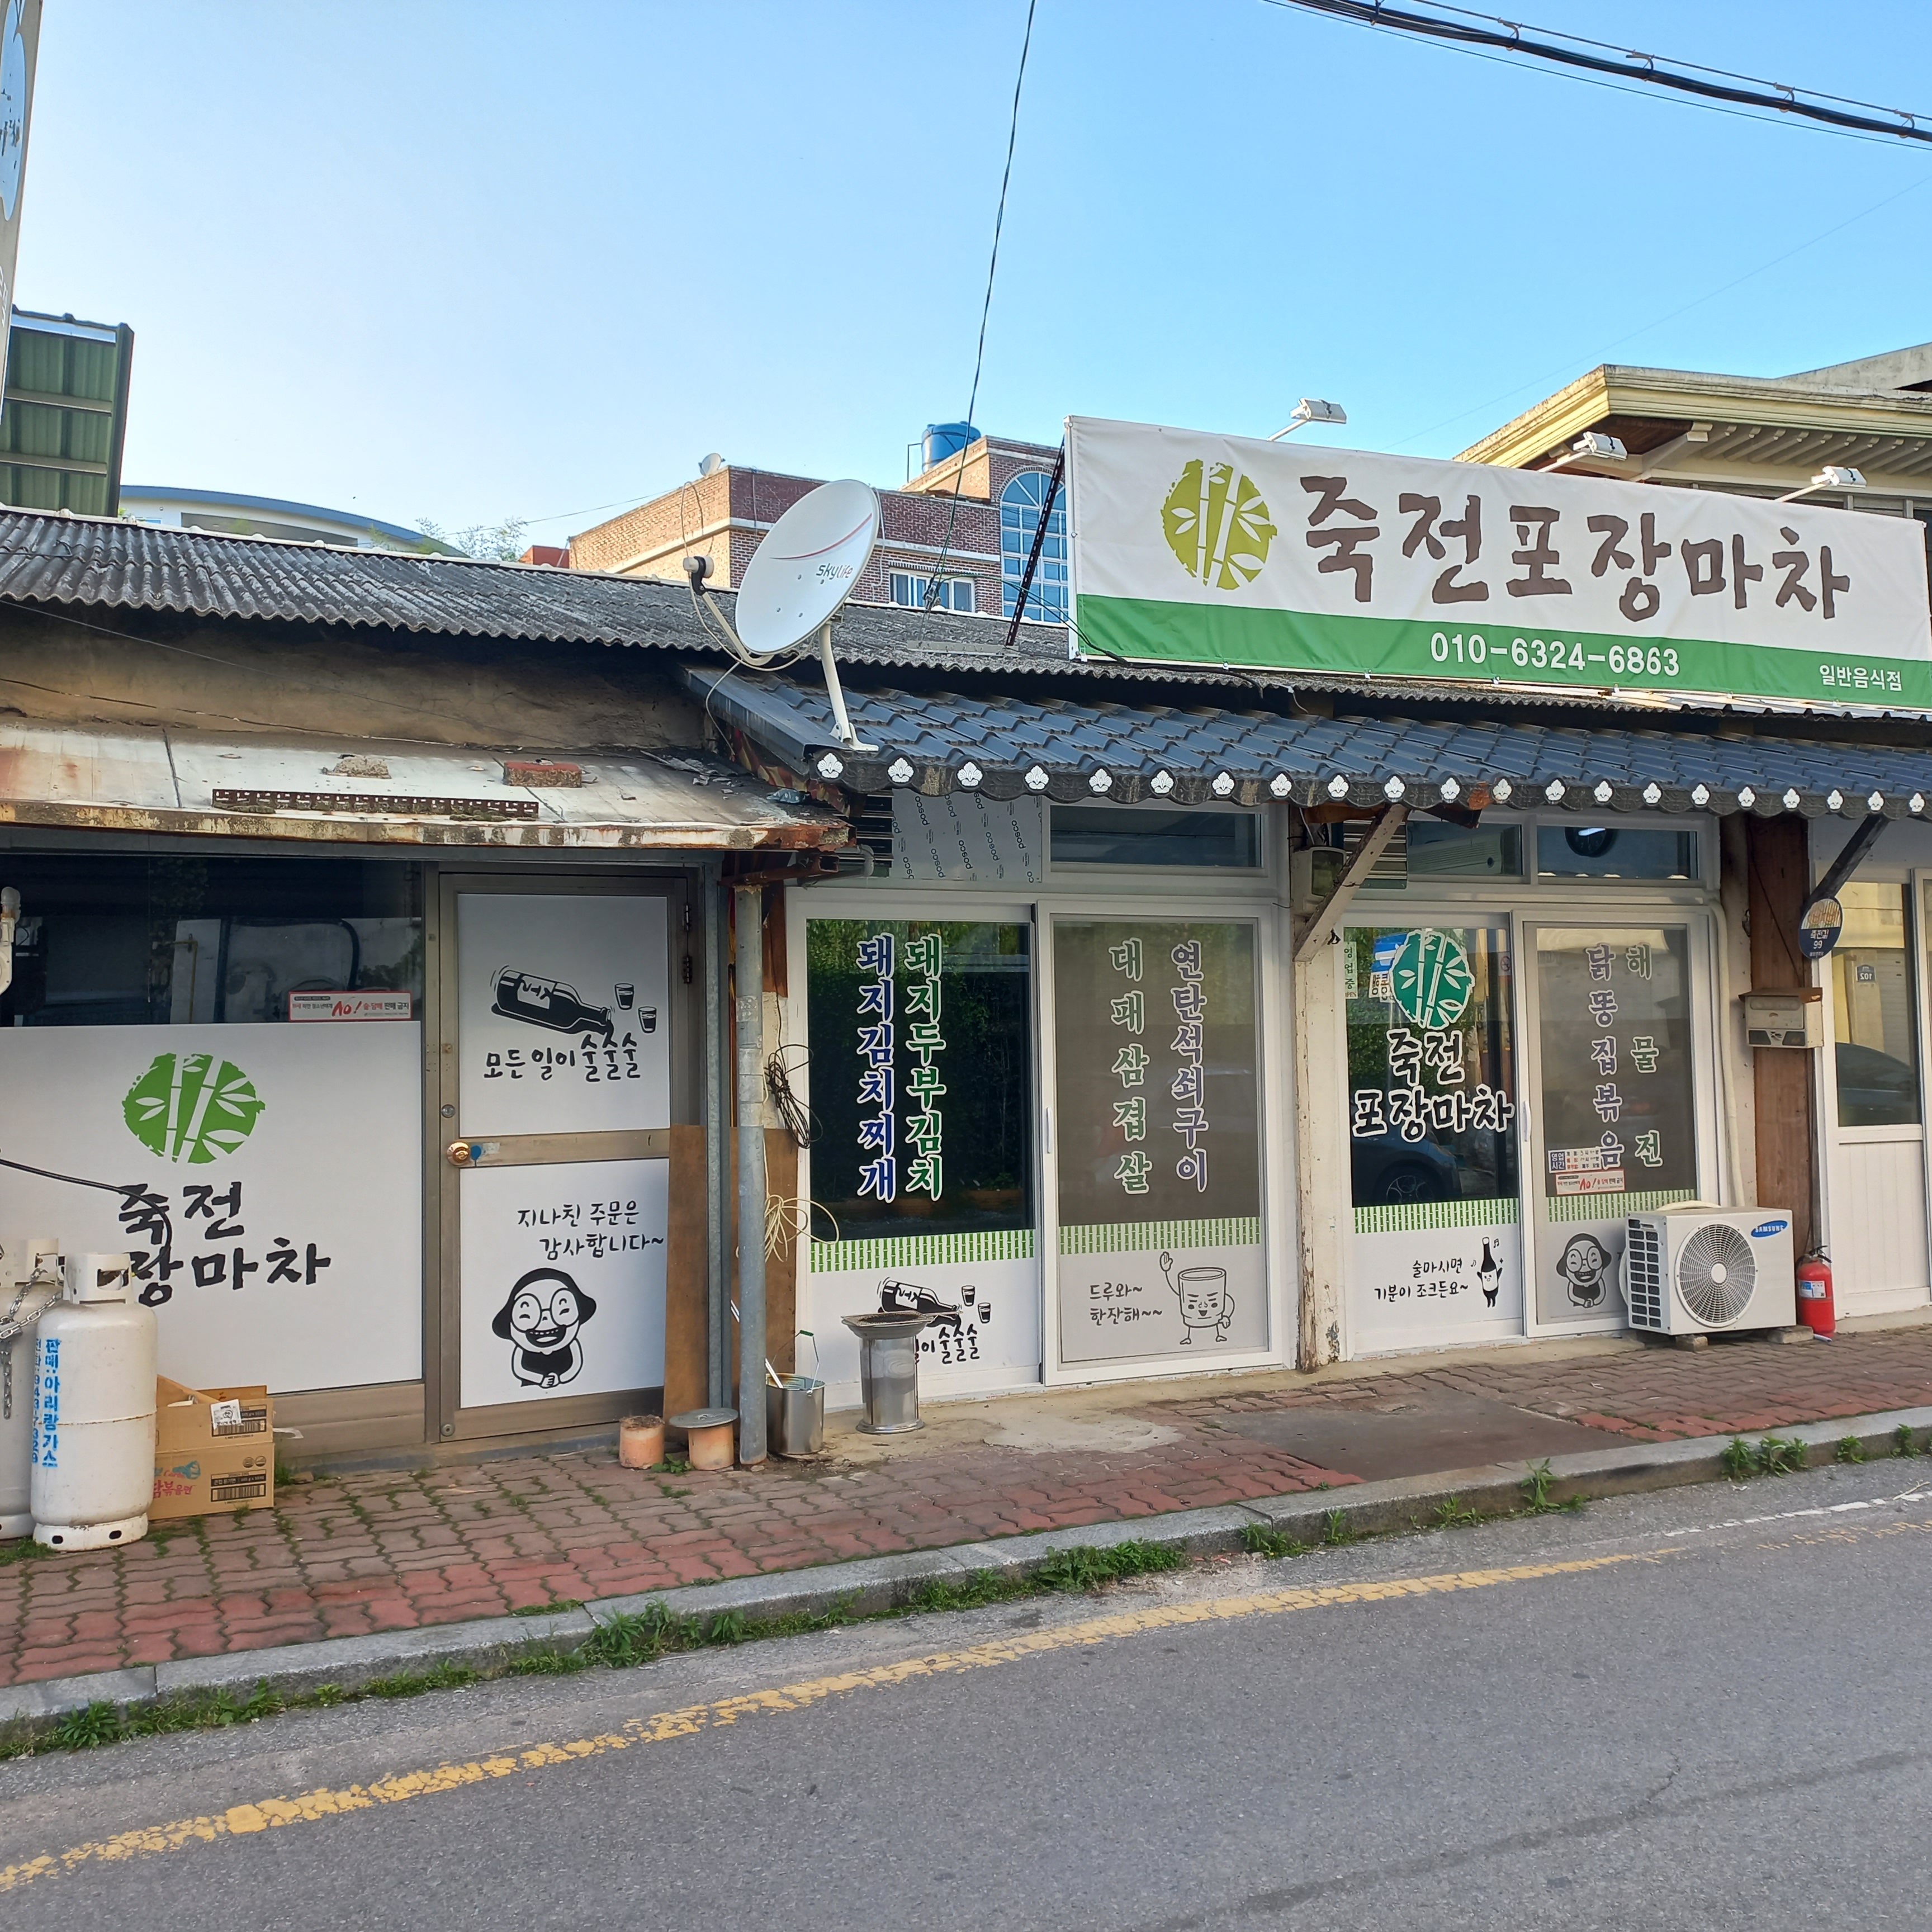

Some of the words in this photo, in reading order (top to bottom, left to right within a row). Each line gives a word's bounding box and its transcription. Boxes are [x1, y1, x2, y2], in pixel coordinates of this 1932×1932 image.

[1300, 475, 1850, 622] 죽전포장마차
[1430, 632, 1680, 676] 010-6324-6863
[1819, 664, 1902, 692] 일반음식점
[915, 795, 930, 826] posco
[986, 831, 1000, 861] posco
[1011, 820, 1026, 849] posco
[930, 848, 946, 878] posco
[958, 840, 973, 869] posco
[1813, 940, 1822, 949] 99
[484, 1048, 525, 1079] 모든
[531, 1046, 576, 1081] 일이
[580, 1031, 641, 1083] 술술술
[1386, 1027, 1465, 1086] 죽전
[1352, 1083, 1515, 1143] 포장마차
[1551, 1153, 1564, 1162] 영업
[1552, 1161, 1565, 1169] 시간
[119, 1181, 245, 1245] 죽전
[517, 1204, 581, 1228] 지나친
[589, 1200, 640, 1226] 주문은
[1755, 1224, 1785, 1233] SAMSUNG
[539, 1233, 664, 1261] 감사합니다~
[122, 1237, 331, 1307] 장마차
[1412, 1257, 1462, 1278] 술마시면
[1090, 1282, 1143, 1300] 드루와~
[1374, 1284, 1411, 1302] 기분이
[1417, 1281, 1469, 1298] 조크든요~
[1090, 1306, 1163, 1326] 한잔해~~
[939, 1323, 980, 1365] 술술술
